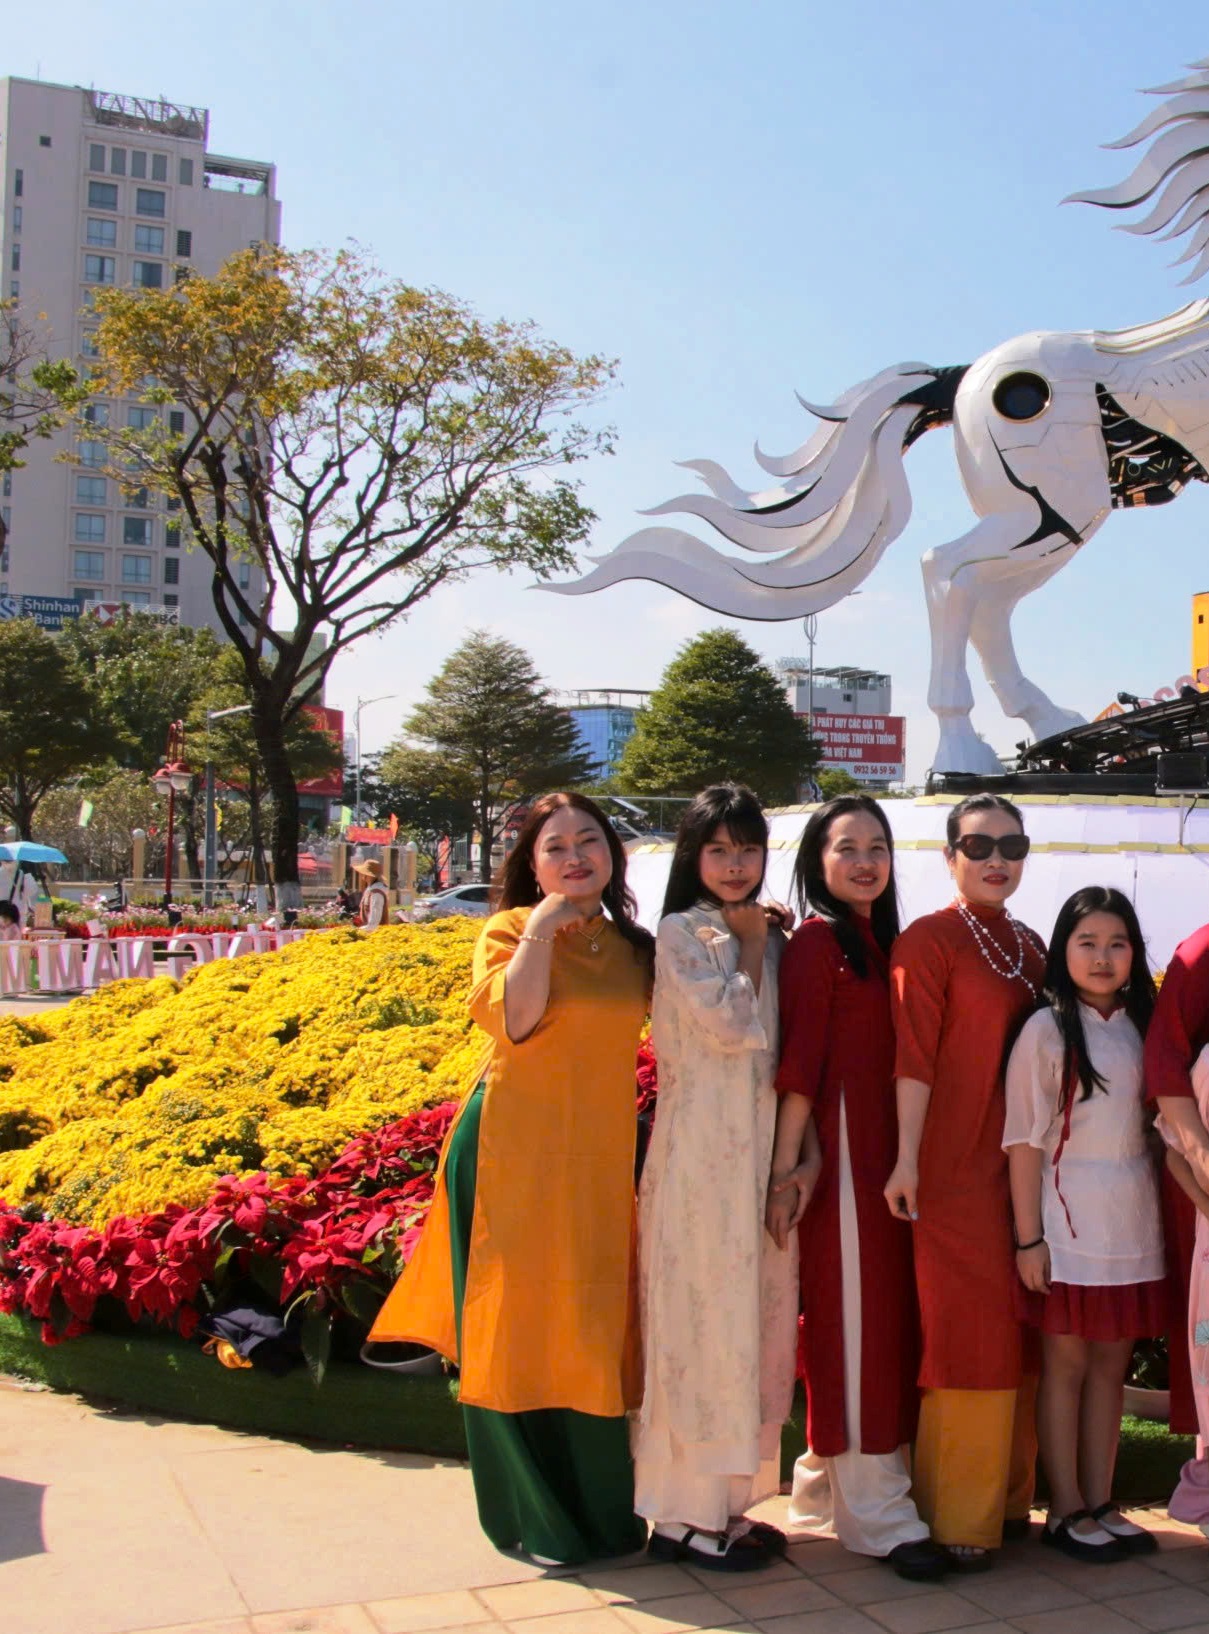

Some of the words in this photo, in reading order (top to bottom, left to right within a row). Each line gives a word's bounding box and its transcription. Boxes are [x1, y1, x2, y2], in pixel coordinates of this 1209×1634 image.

[24, 600, 80, 613] Shinhan
[34, 614, 64, 625] Ban
[833, 746, 847, 759] VIỆT
[848, 747, 863, 758] NAM
[853, 765, 869, 775] 0932
